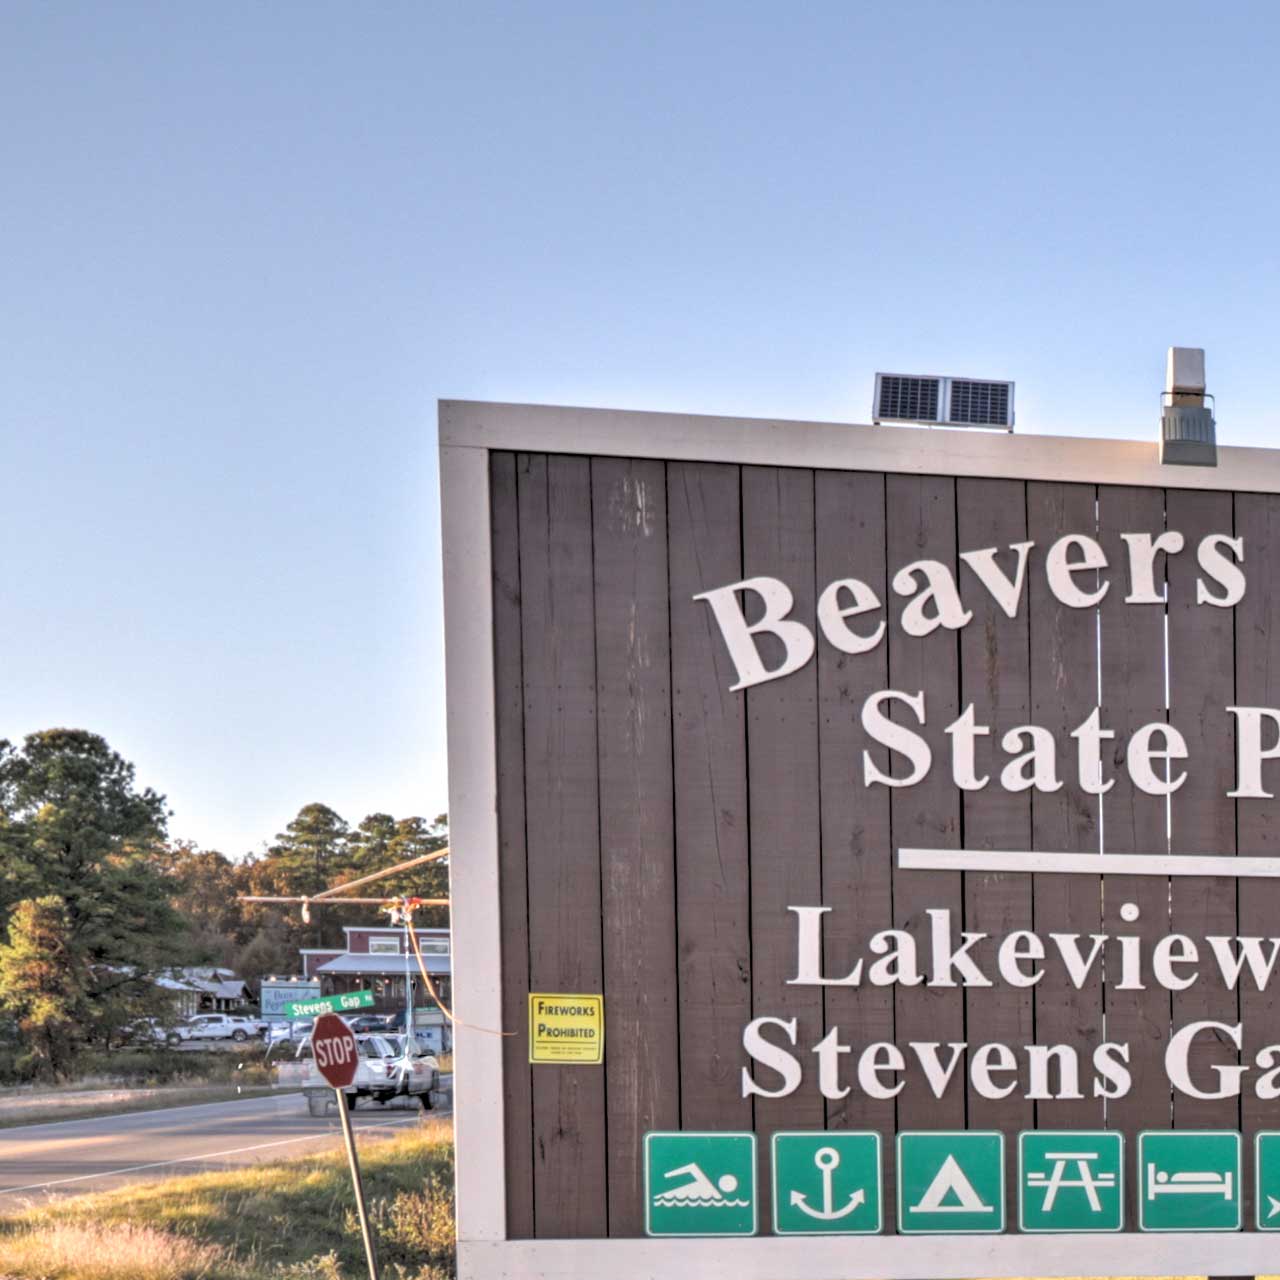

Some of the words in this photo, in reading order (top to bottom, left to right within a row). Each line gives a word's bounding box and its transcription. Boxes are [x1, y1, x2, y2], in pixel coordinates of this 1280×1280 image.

[693, 530, 1245, 692] Beavers
[862, 689, 1189, 796] State
[292, 1001, 333, 1016] Stevens
[340, 996, 361, 1008] Gap
[538, 1001, 595, 1016] FIREWORKS
[538, 1024, 596, 1038] PROHIBITED
[315, 1036, 354, 1067] STOP
[742, 1015, 1132, 1101] Stevens
